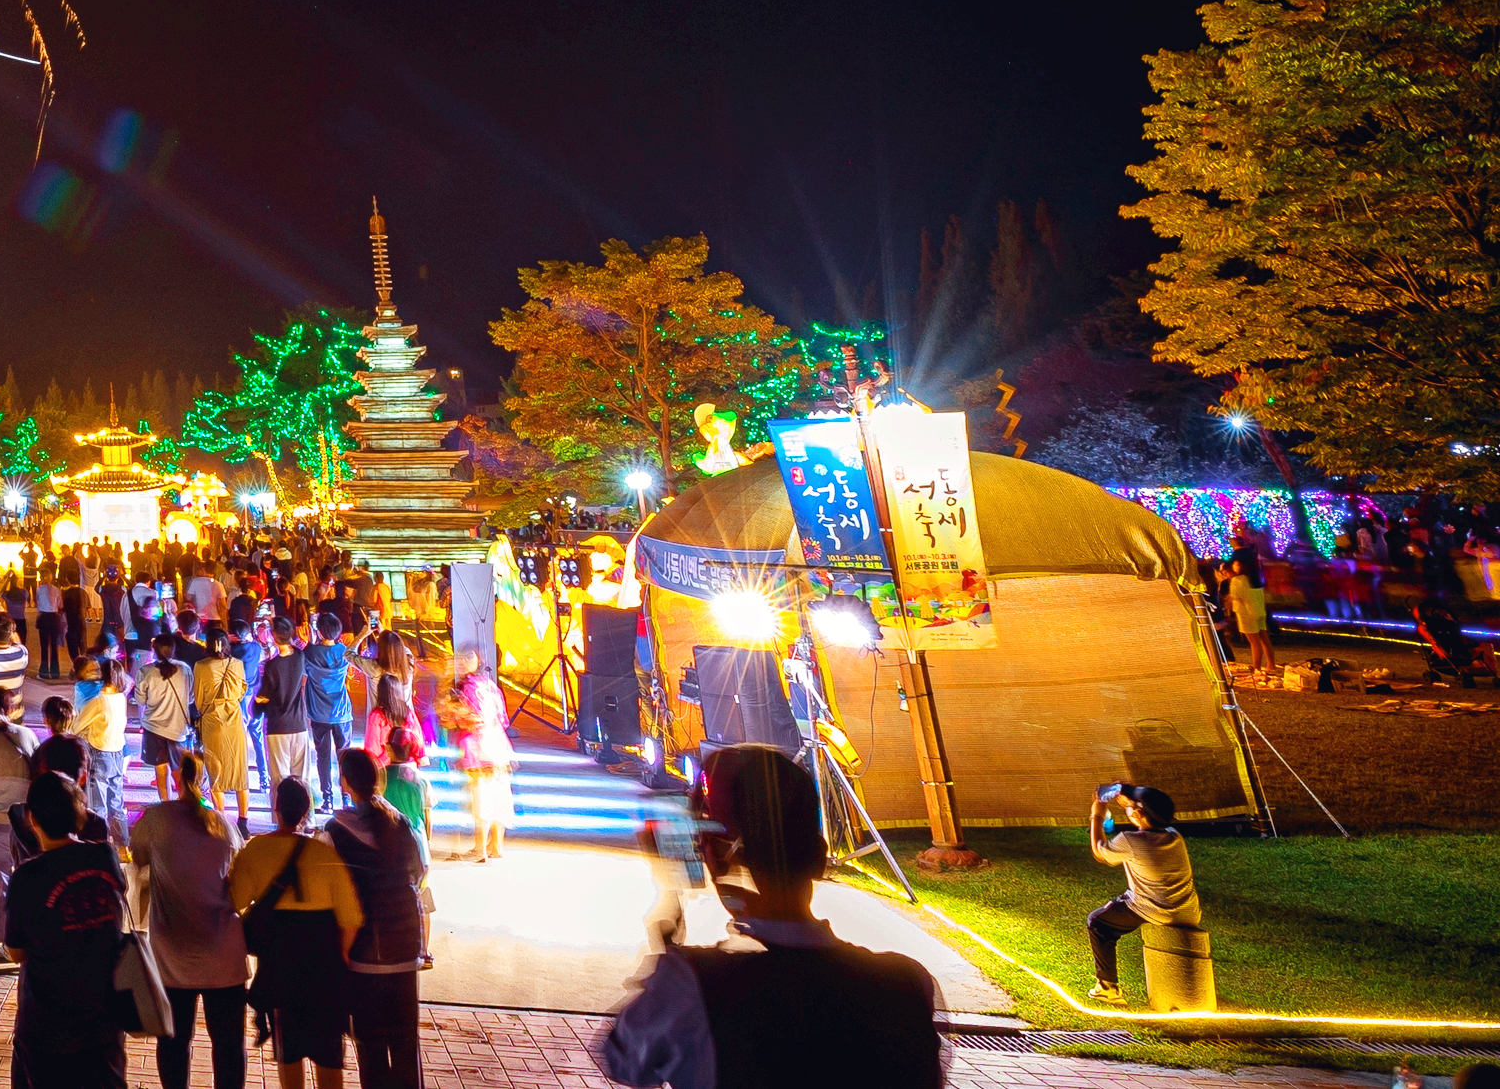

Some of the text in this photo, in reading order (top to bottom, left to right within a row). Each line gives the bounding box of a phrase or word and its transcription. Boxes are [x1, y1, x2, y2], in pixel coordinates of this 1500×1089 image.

[802, 469, 859, 510] 서동
[903, 468, 958, 507] 서동
[815, 505, 870, 551] 축제
[915, 503, 967, 548] 축제
